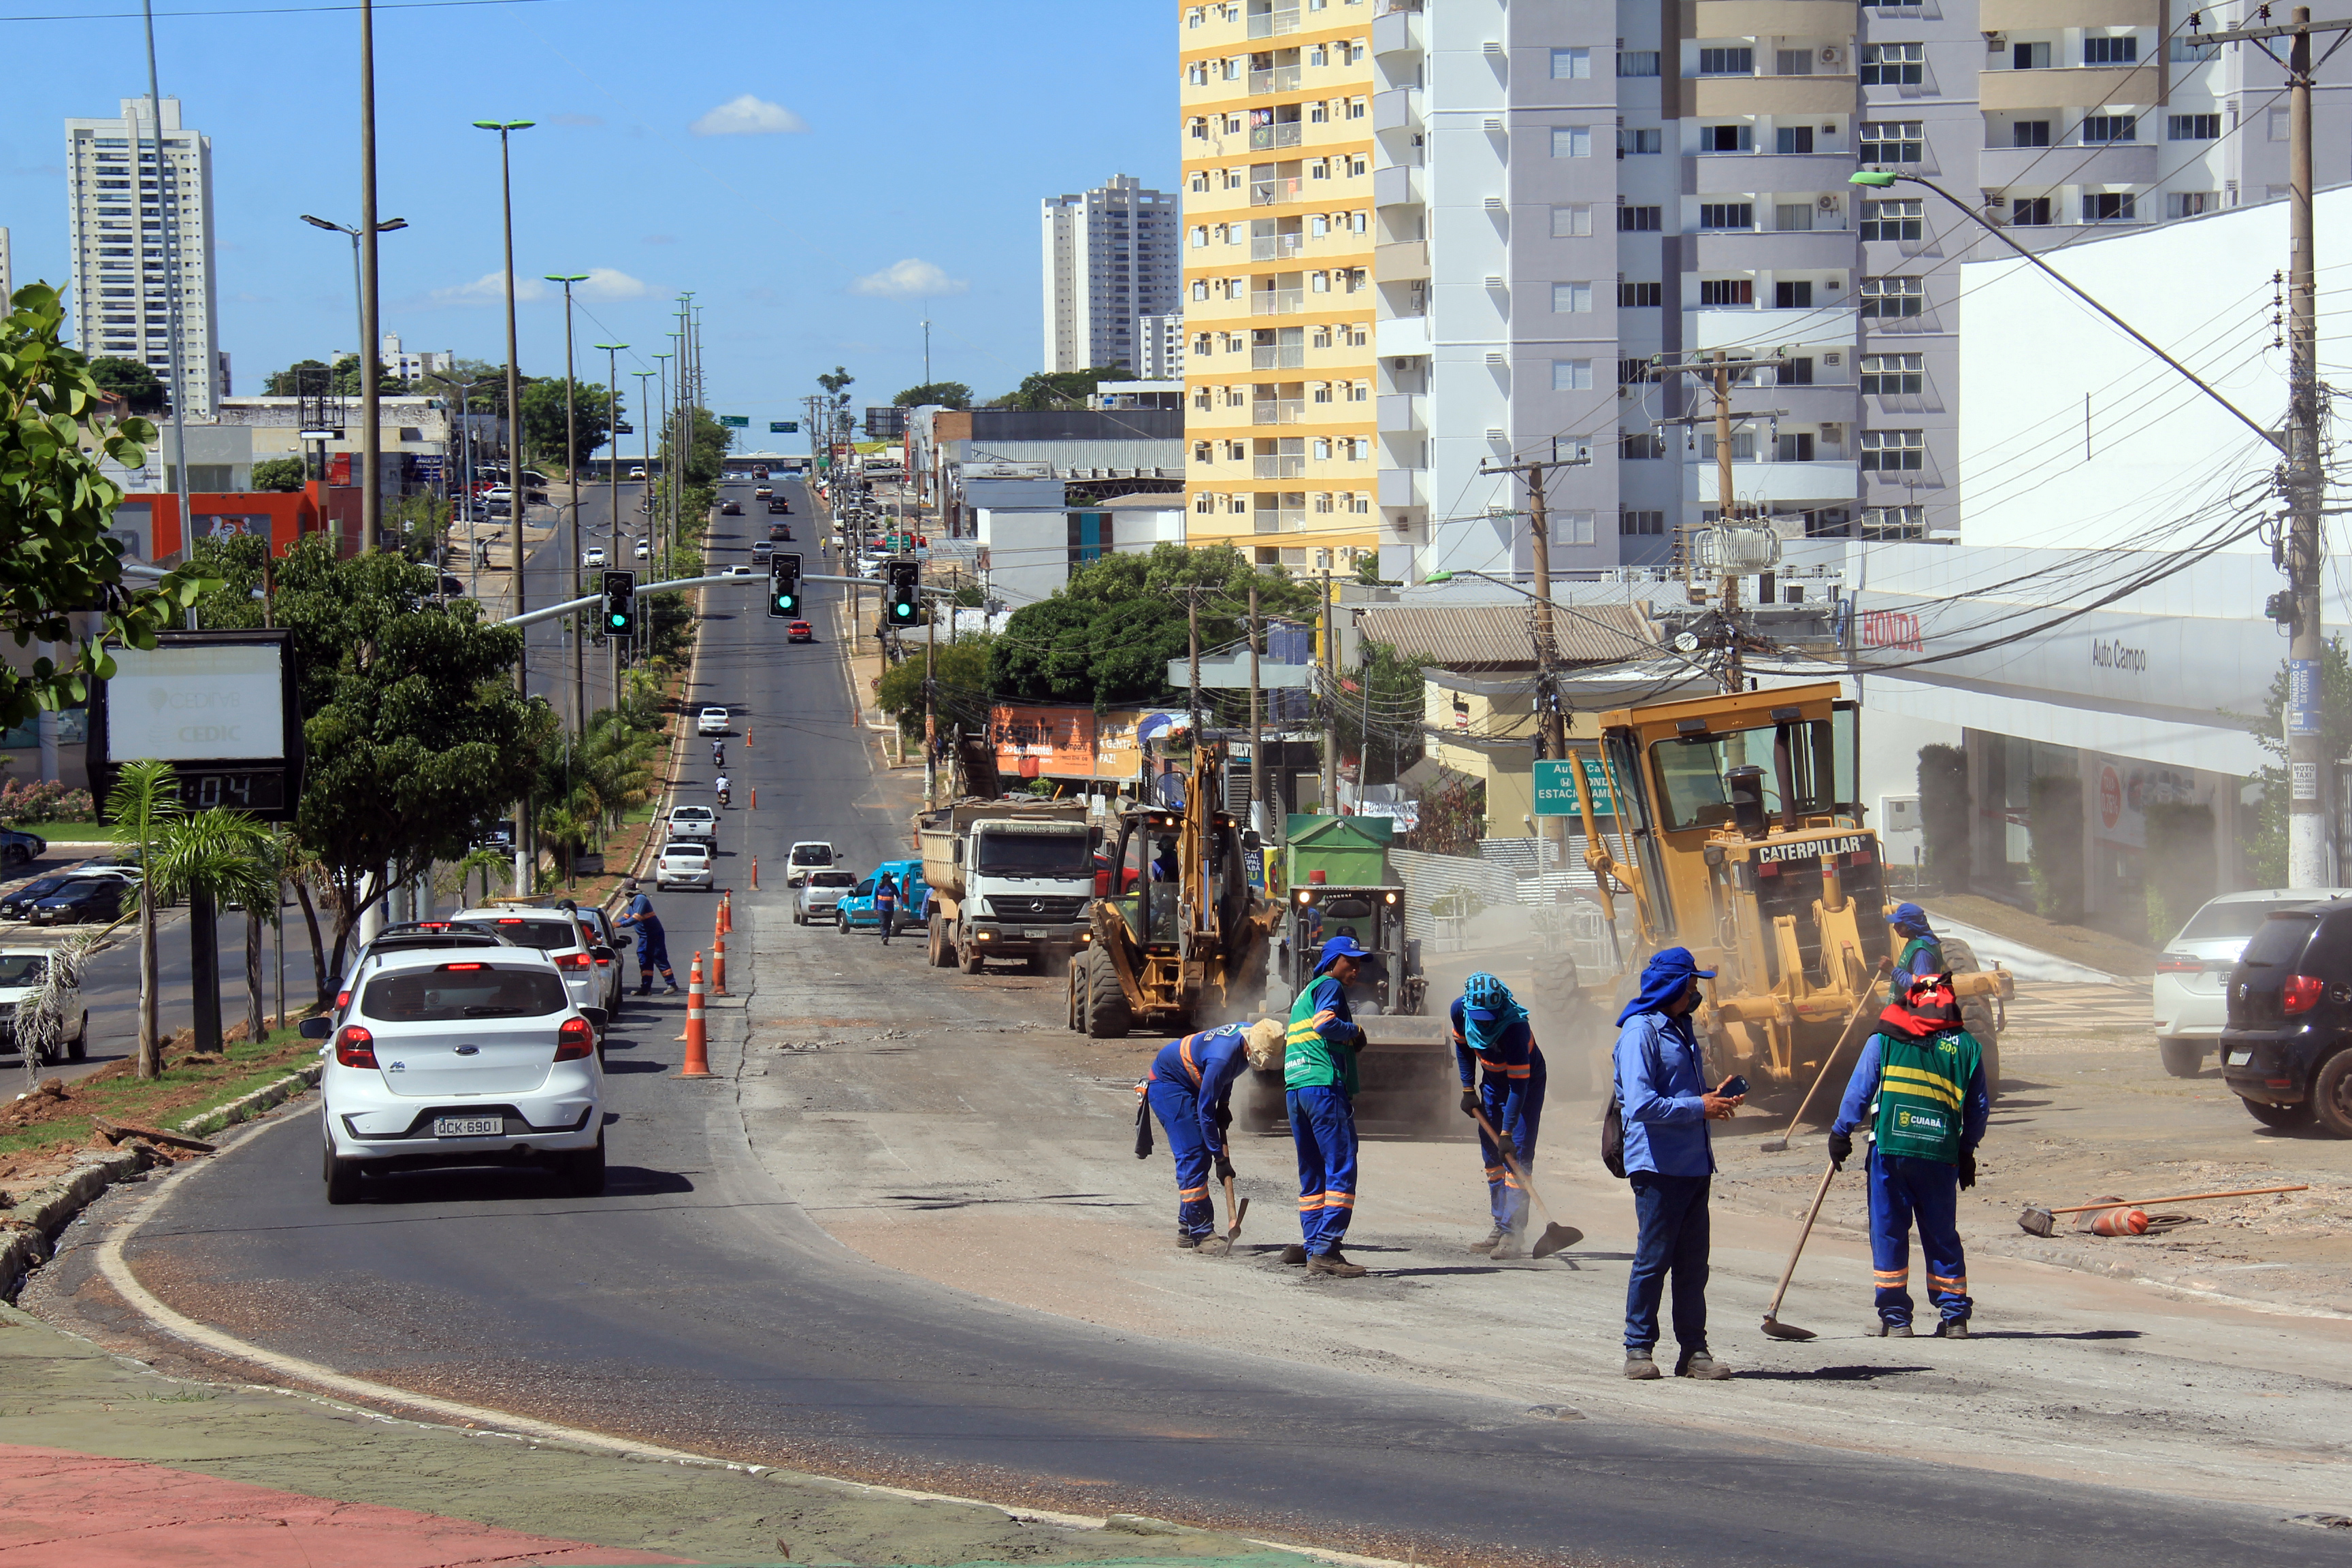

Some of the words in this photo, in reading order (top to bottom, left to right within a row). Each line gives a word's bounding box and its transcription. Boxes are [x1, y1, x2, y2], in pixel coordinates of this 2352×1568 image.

[1863, 608, 1923, 653] HONDA
[2093, 638, 2112, 668] Auto
[2114, 638, 2146, 676] Campo
[2300, 670, 2308, 693] COSTA
[2291, 670, 2300, 711] FERNANDO
[995, 717, 1053, 749] seguir
[1105, 723, 1135, 734] SEGURO
[1027, 744, 1053, 755] frente!
[1106, 738, 1132, 749] GENTE
[1098, 753, 1116, 764] FAZ!
[1553, 764, 1573, 773] Aut
[1588, 777, 1617, 787] ONDA
[1538, 789, 1622, 799] ESTACIAMEN
[1005, 824, 1071, 834] Mercedes-Benz
[1759, 836, 1861, 864] CATERPILLAR
[1938, 1041, 1957, 1055] 300
[1284, 1056, 1305, 1071] CUIABÁ
[1910, 1115, 1942, 1128] CUIABÁ
